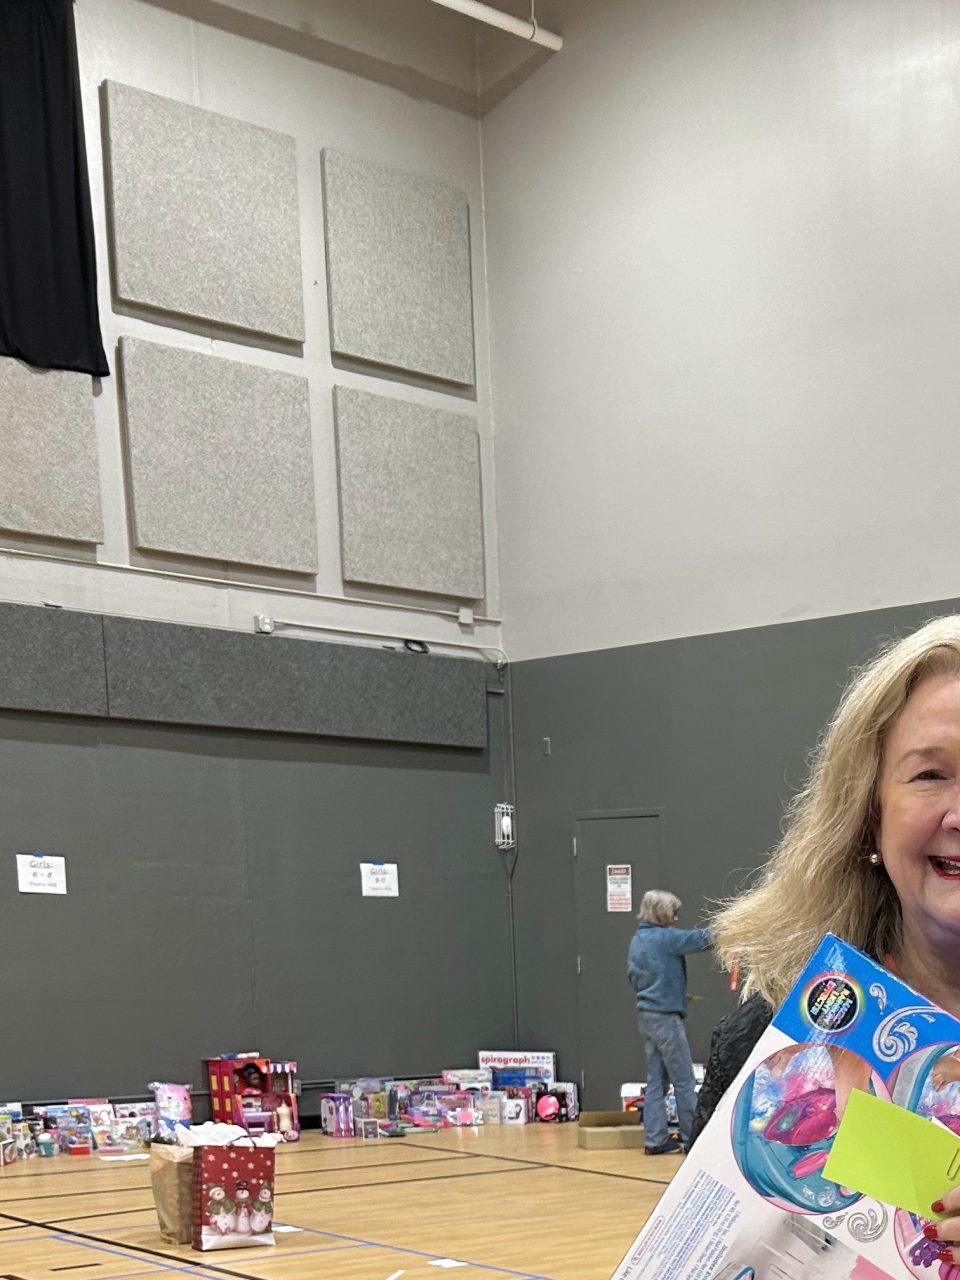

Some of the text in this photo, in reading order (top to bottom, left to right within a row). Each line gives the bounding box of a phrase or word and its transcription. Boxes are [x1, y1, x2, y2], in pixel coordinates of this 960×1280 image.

[820, 990, 838, 1014] LIGHT
[481, 1055, 530, 1065] spirograph
[621, 1265, 632, 1278] Like
